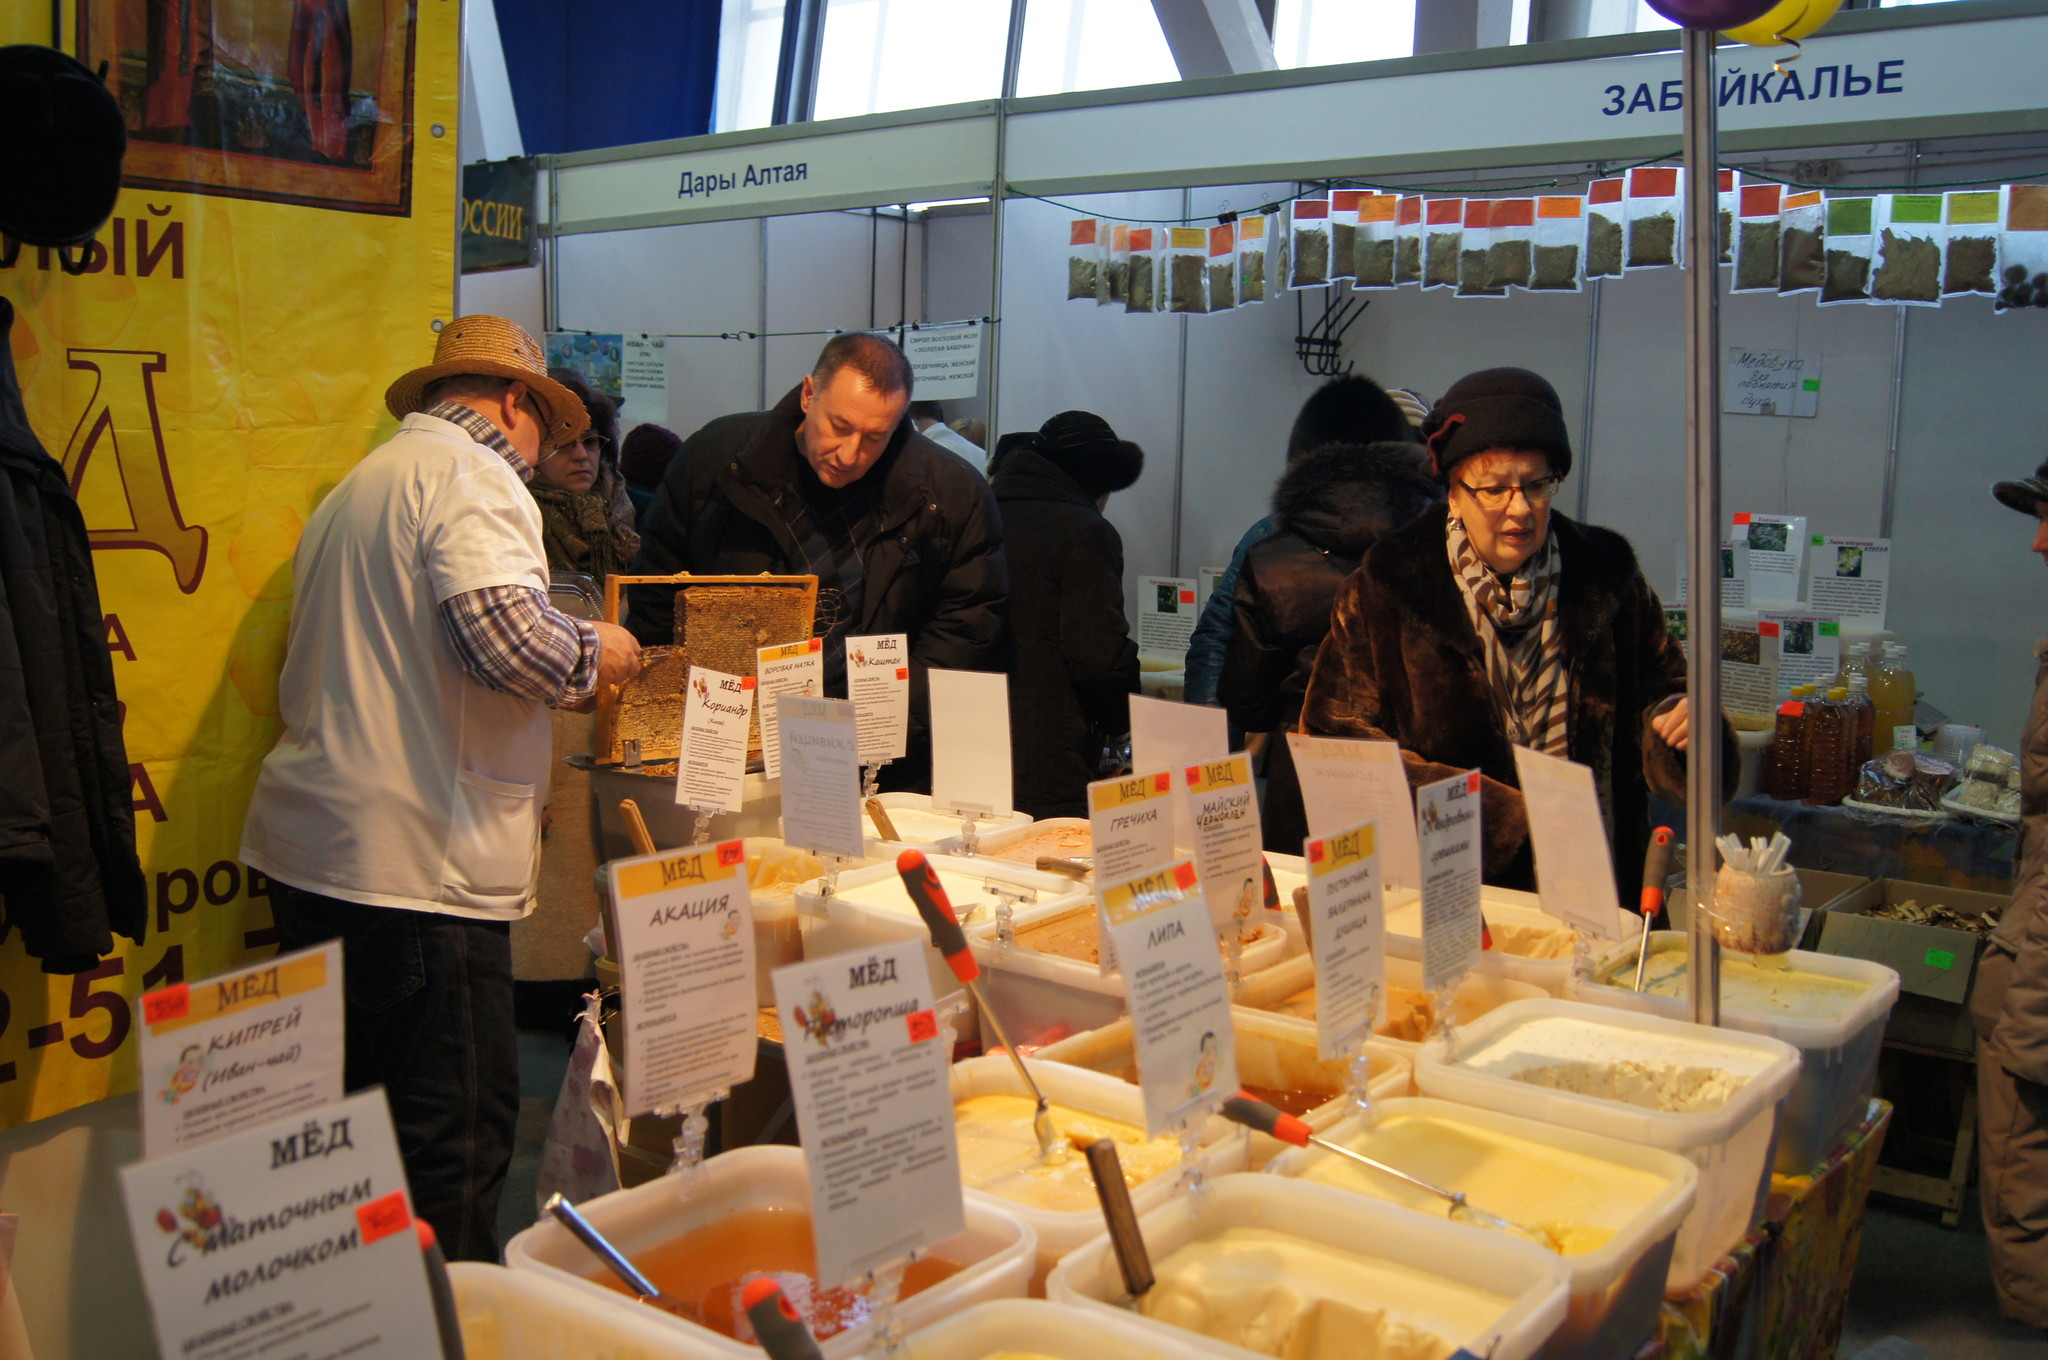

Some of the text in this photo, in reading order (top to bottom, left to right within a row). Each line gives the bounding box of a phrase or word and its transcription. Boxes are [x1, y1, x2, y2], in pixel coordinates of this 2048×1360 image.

[1602, 59, 1904, 116] ЗАБЙКАЛЬЕ
[678, 163, 808, 199] Дары Алтая
[878, 638, 897, 650] МЁД
[868, 657, 901, 667] Каштан
[720, 679, 742, 694] МЁД
[702, 698, 749, 719] Кориандр
[1119, 778, 1146, 802] МЁД
[1205, 763, 1235, 786] МЁД
[1110, 808, 1158, 832] ГРЕЧИХА
[660, 855, 706, 887] МЁД
[648, 894, 730, 928] АКАЦИЯ
[1147, 920, 1185, 949] ЛИПА
[216, 965, 281, 1013] МЁД
[848, 956, 898, 990] МЁД
[207, 1005, 302, 1055] КИПРЕЙ
[270, 1116, 354, 1170] МЁД
[204, 1228, 358, 1305] молочком
